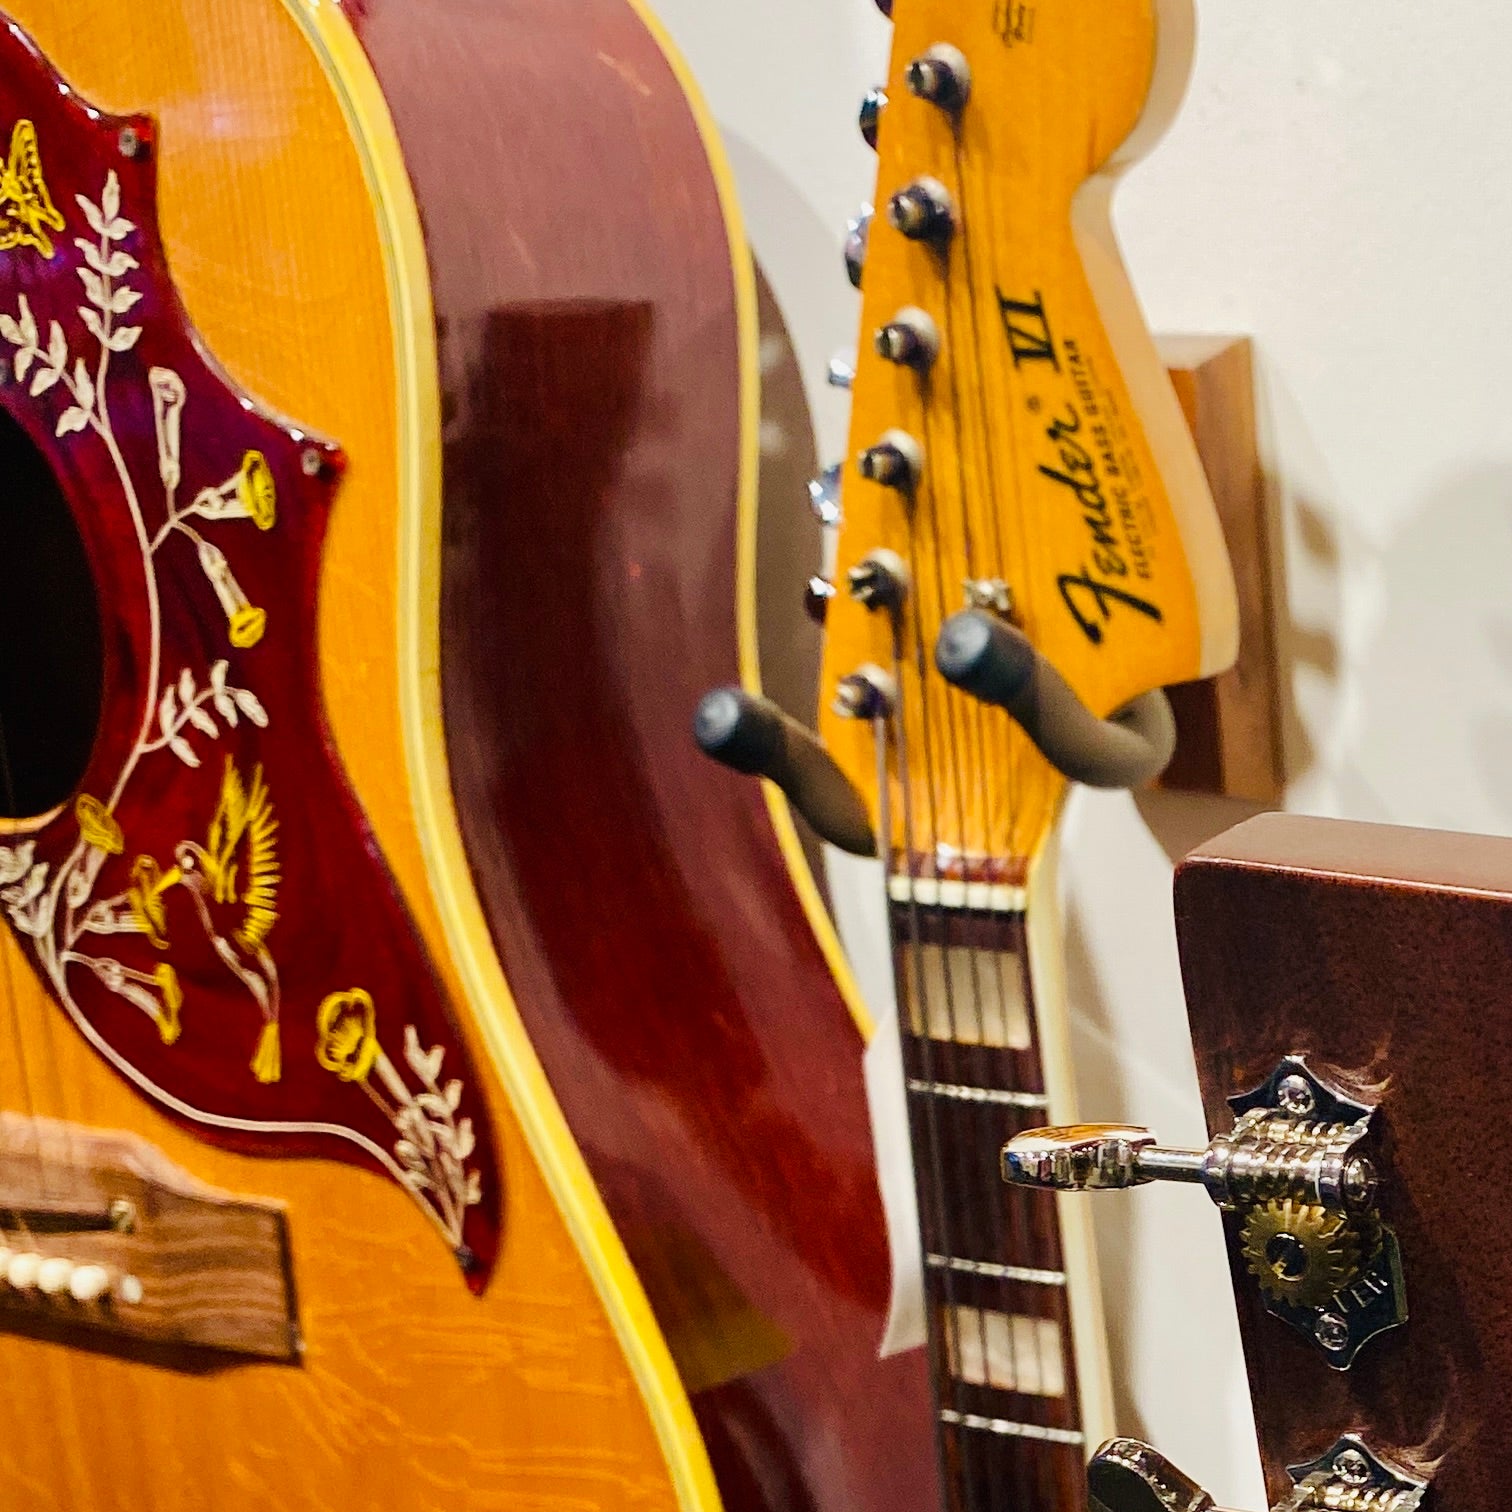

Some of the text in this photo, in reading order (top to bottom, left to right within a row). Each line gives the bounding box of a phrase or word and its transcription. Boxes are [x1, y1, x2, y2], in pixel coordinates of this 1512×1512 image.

[995, 284, 1061, 373] VI
[1063, 338, 1099, 416] GUITAR
[1091, 425, 1120, 477] BASS
[1037, 402, 1163, 644] Fender
[1111, 487, 1153, 580] ELECTRIC
